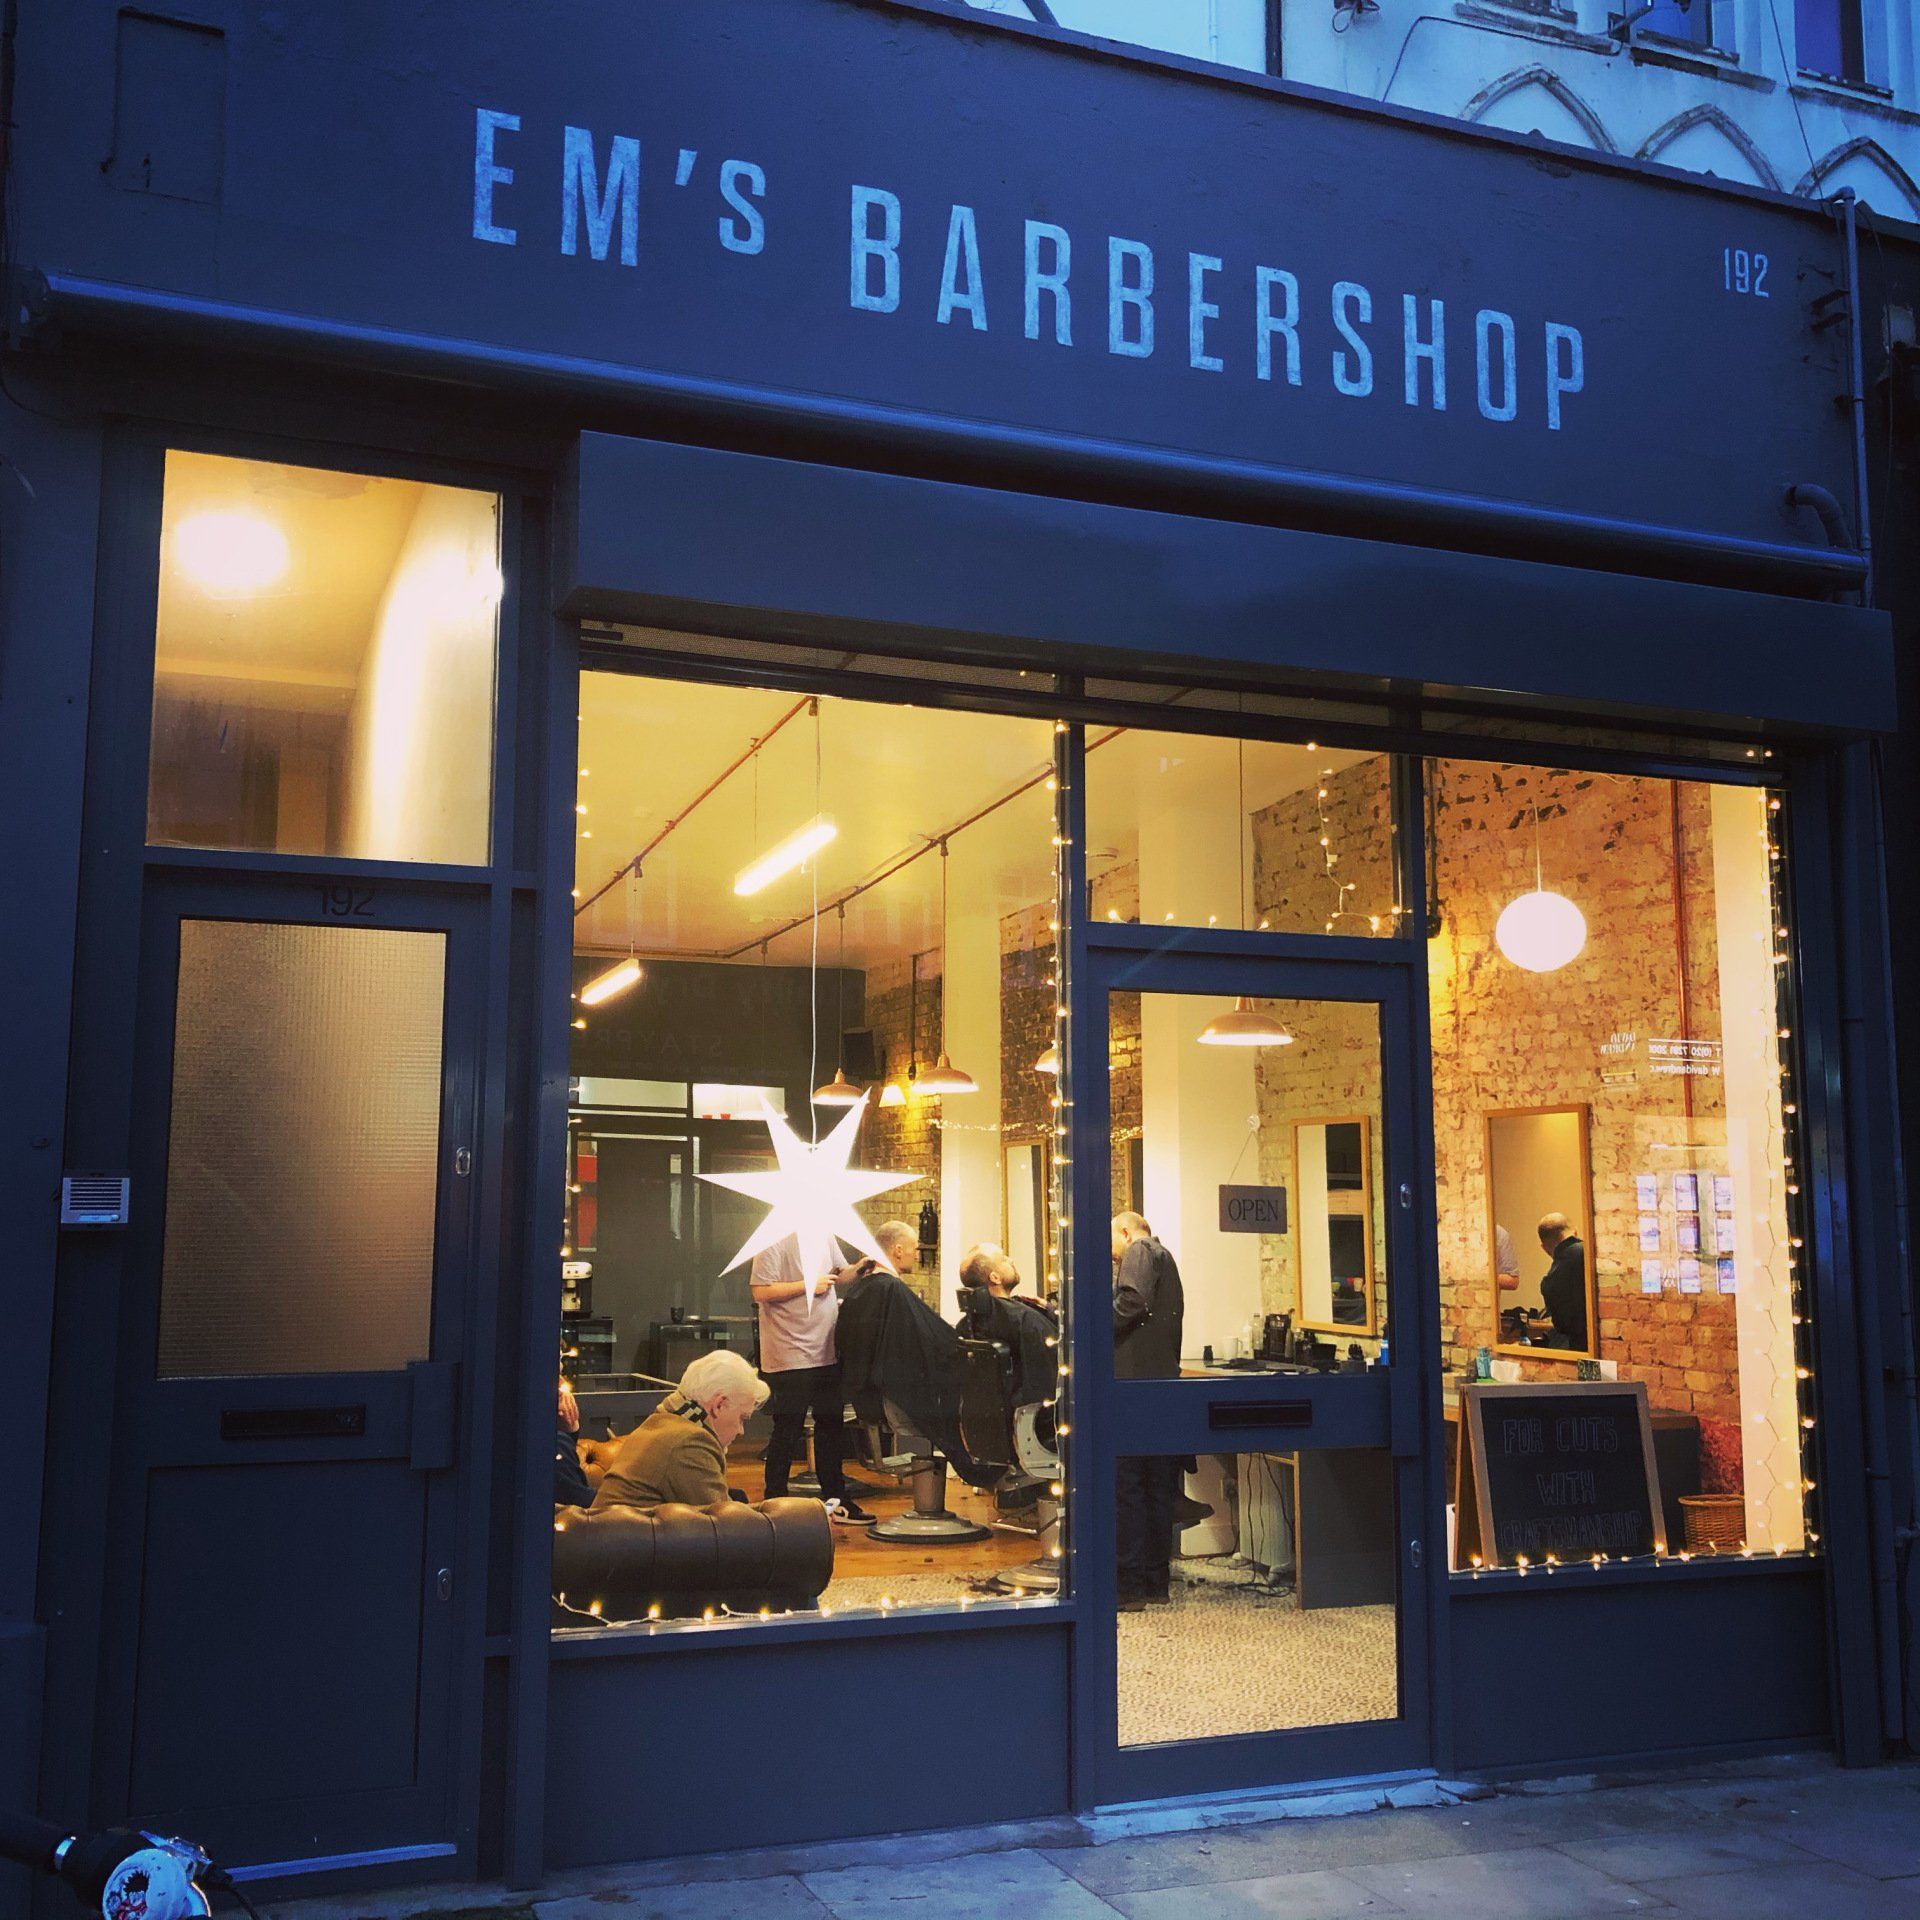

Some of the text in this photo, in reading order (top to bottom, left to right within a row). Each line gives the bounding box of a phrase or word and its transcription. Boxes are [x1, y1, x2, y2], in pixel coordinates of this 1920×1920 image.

[1724, 247, 1770, 299] 192
[850, 184, 1585, 431] BARBERSHOP
[319, 884, 377, 917] 192
[1227, 1198, 1279, 1222] OPEN
[1502, 1416, 1618, 1454] FOR CUTS
[1536, 1470, 1598, 1506] WITH
